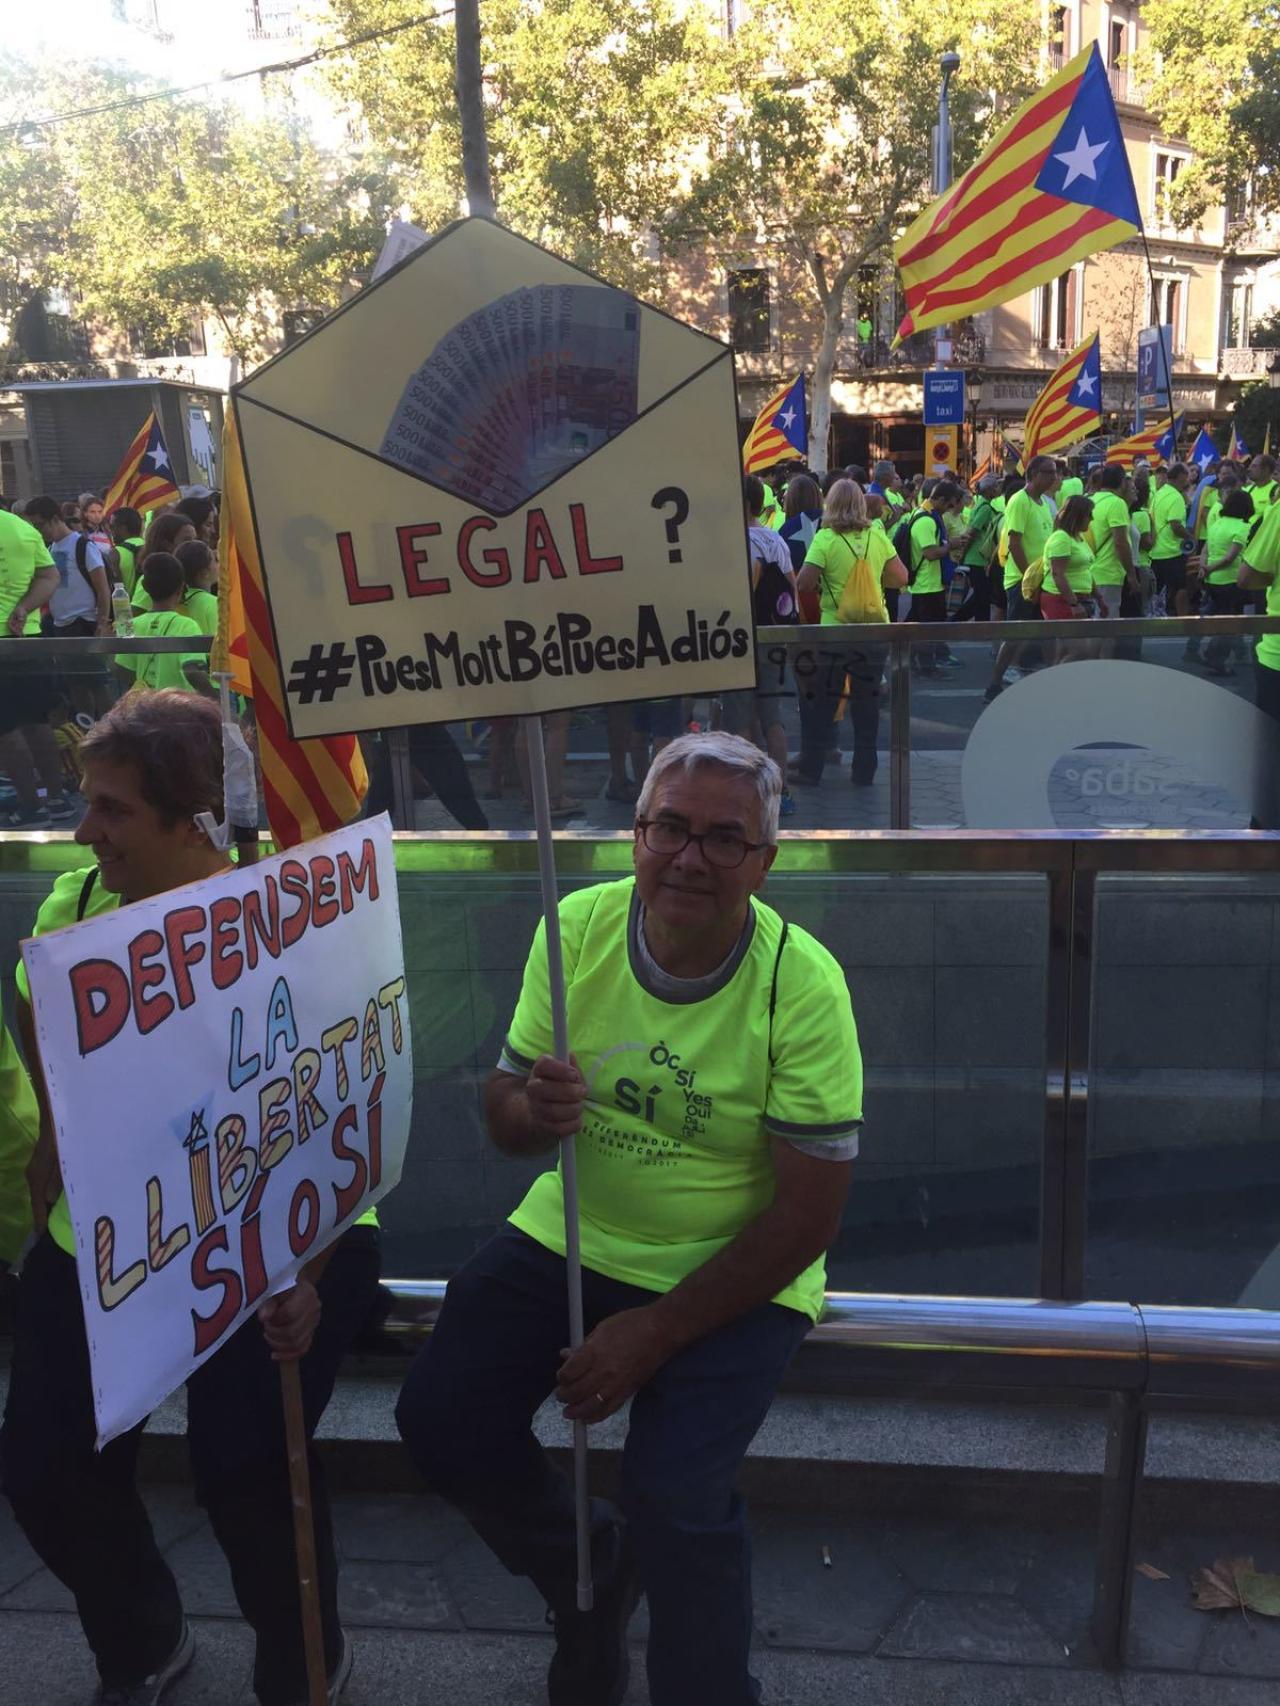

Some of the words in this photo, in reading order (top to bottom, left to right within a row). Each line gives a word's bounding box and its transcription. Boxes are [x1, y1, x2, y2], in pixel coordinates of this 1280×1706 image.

[936, 404, 953, 417] taxi
[336, 503, 623, 605] LEGAL
[651, 486, 689, 564] ?
[68, 838, 379, 1058] DEFENSEM
[228, 975, 299, 1093] LA
[683, 1088, 713, 1107] Yes
